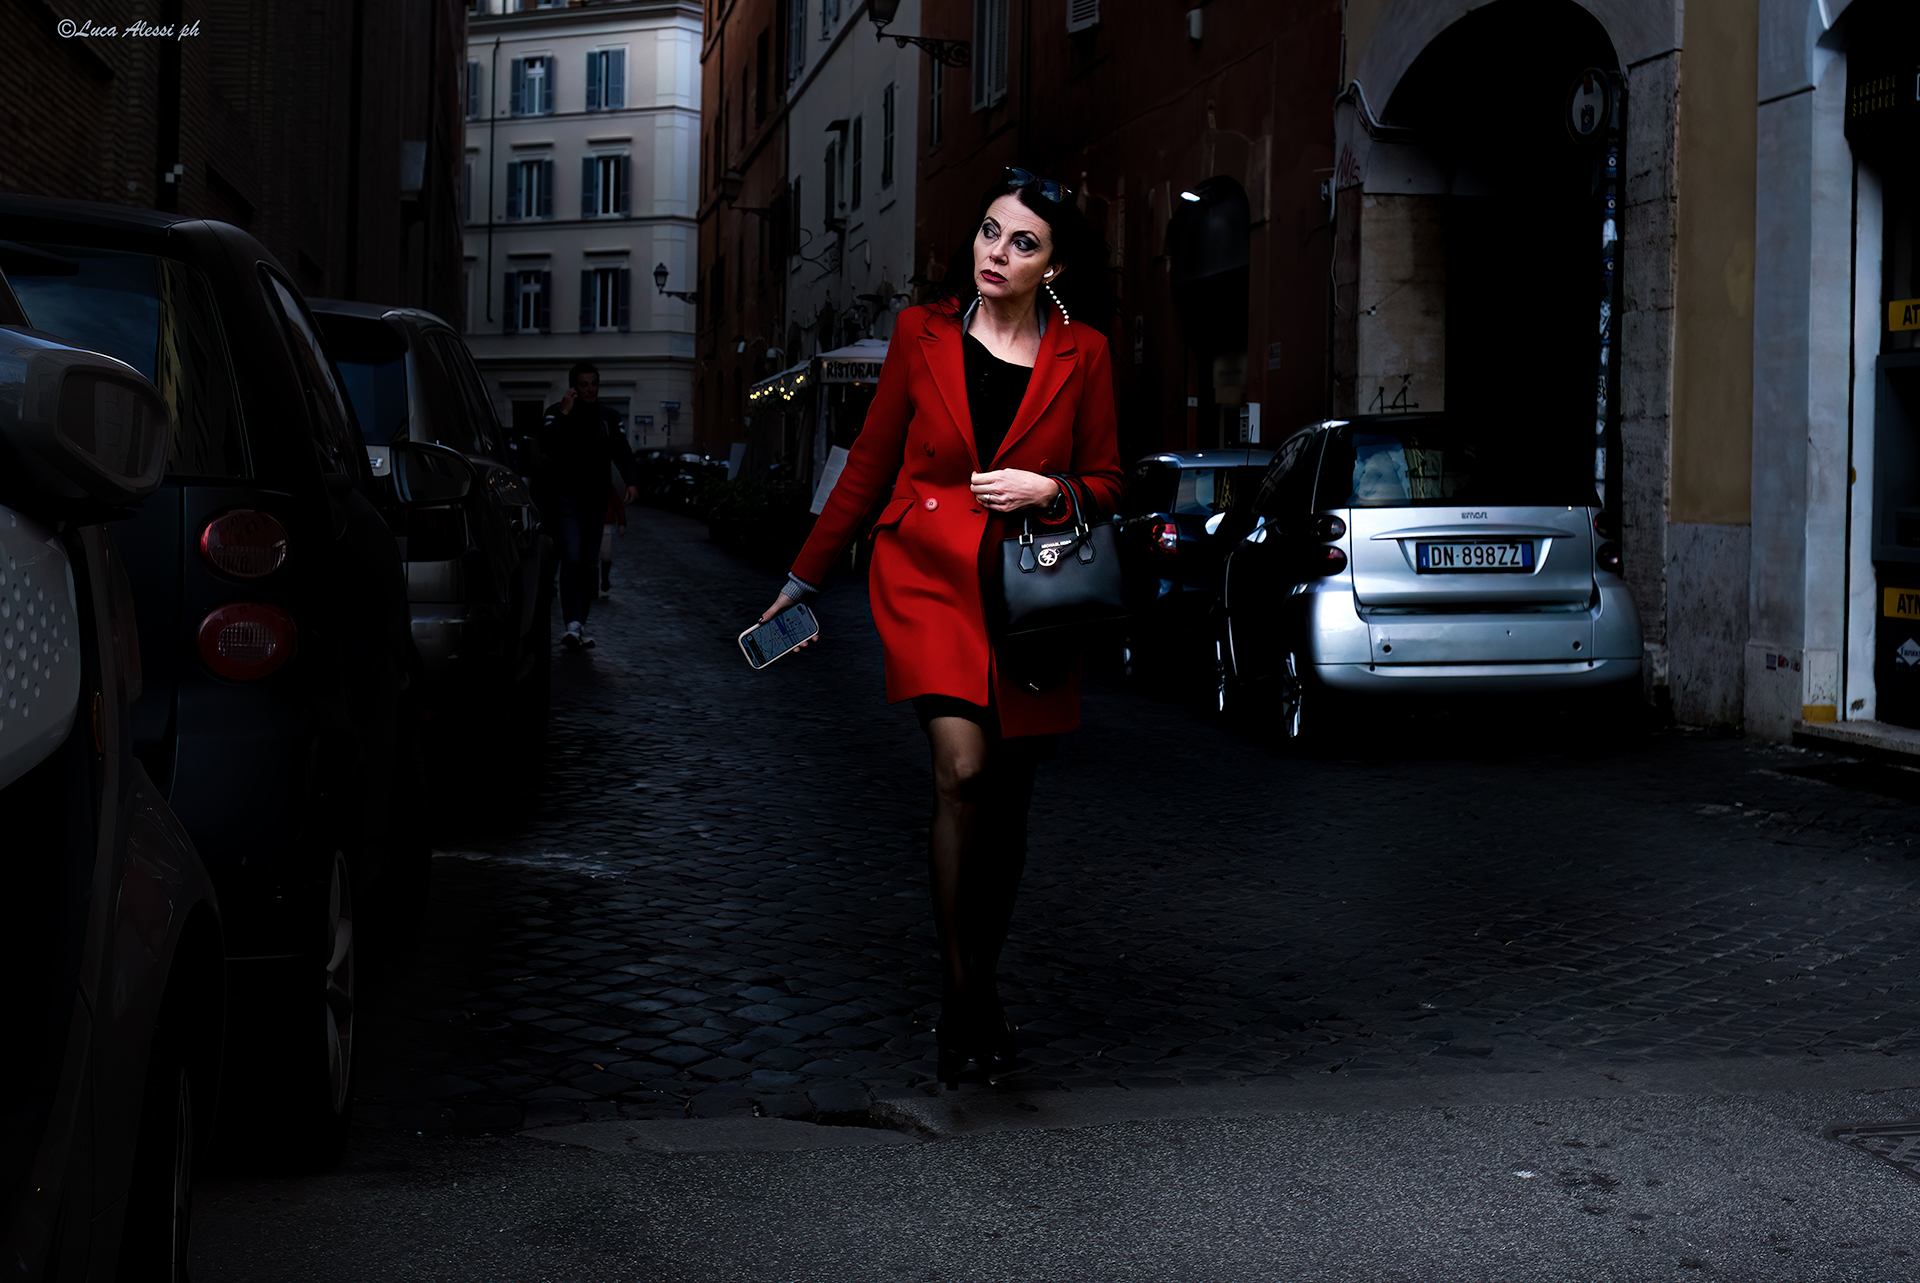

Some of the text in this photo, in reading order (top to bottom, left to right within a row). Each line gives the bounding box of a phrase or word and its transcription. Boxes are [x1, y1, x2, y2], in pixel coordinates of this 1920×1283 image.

[1852, 92, 1895, 117] STORAGE
[1431, 546, 1454, 566] DN
[1462, 545, 1520, 566] 898ZZ
